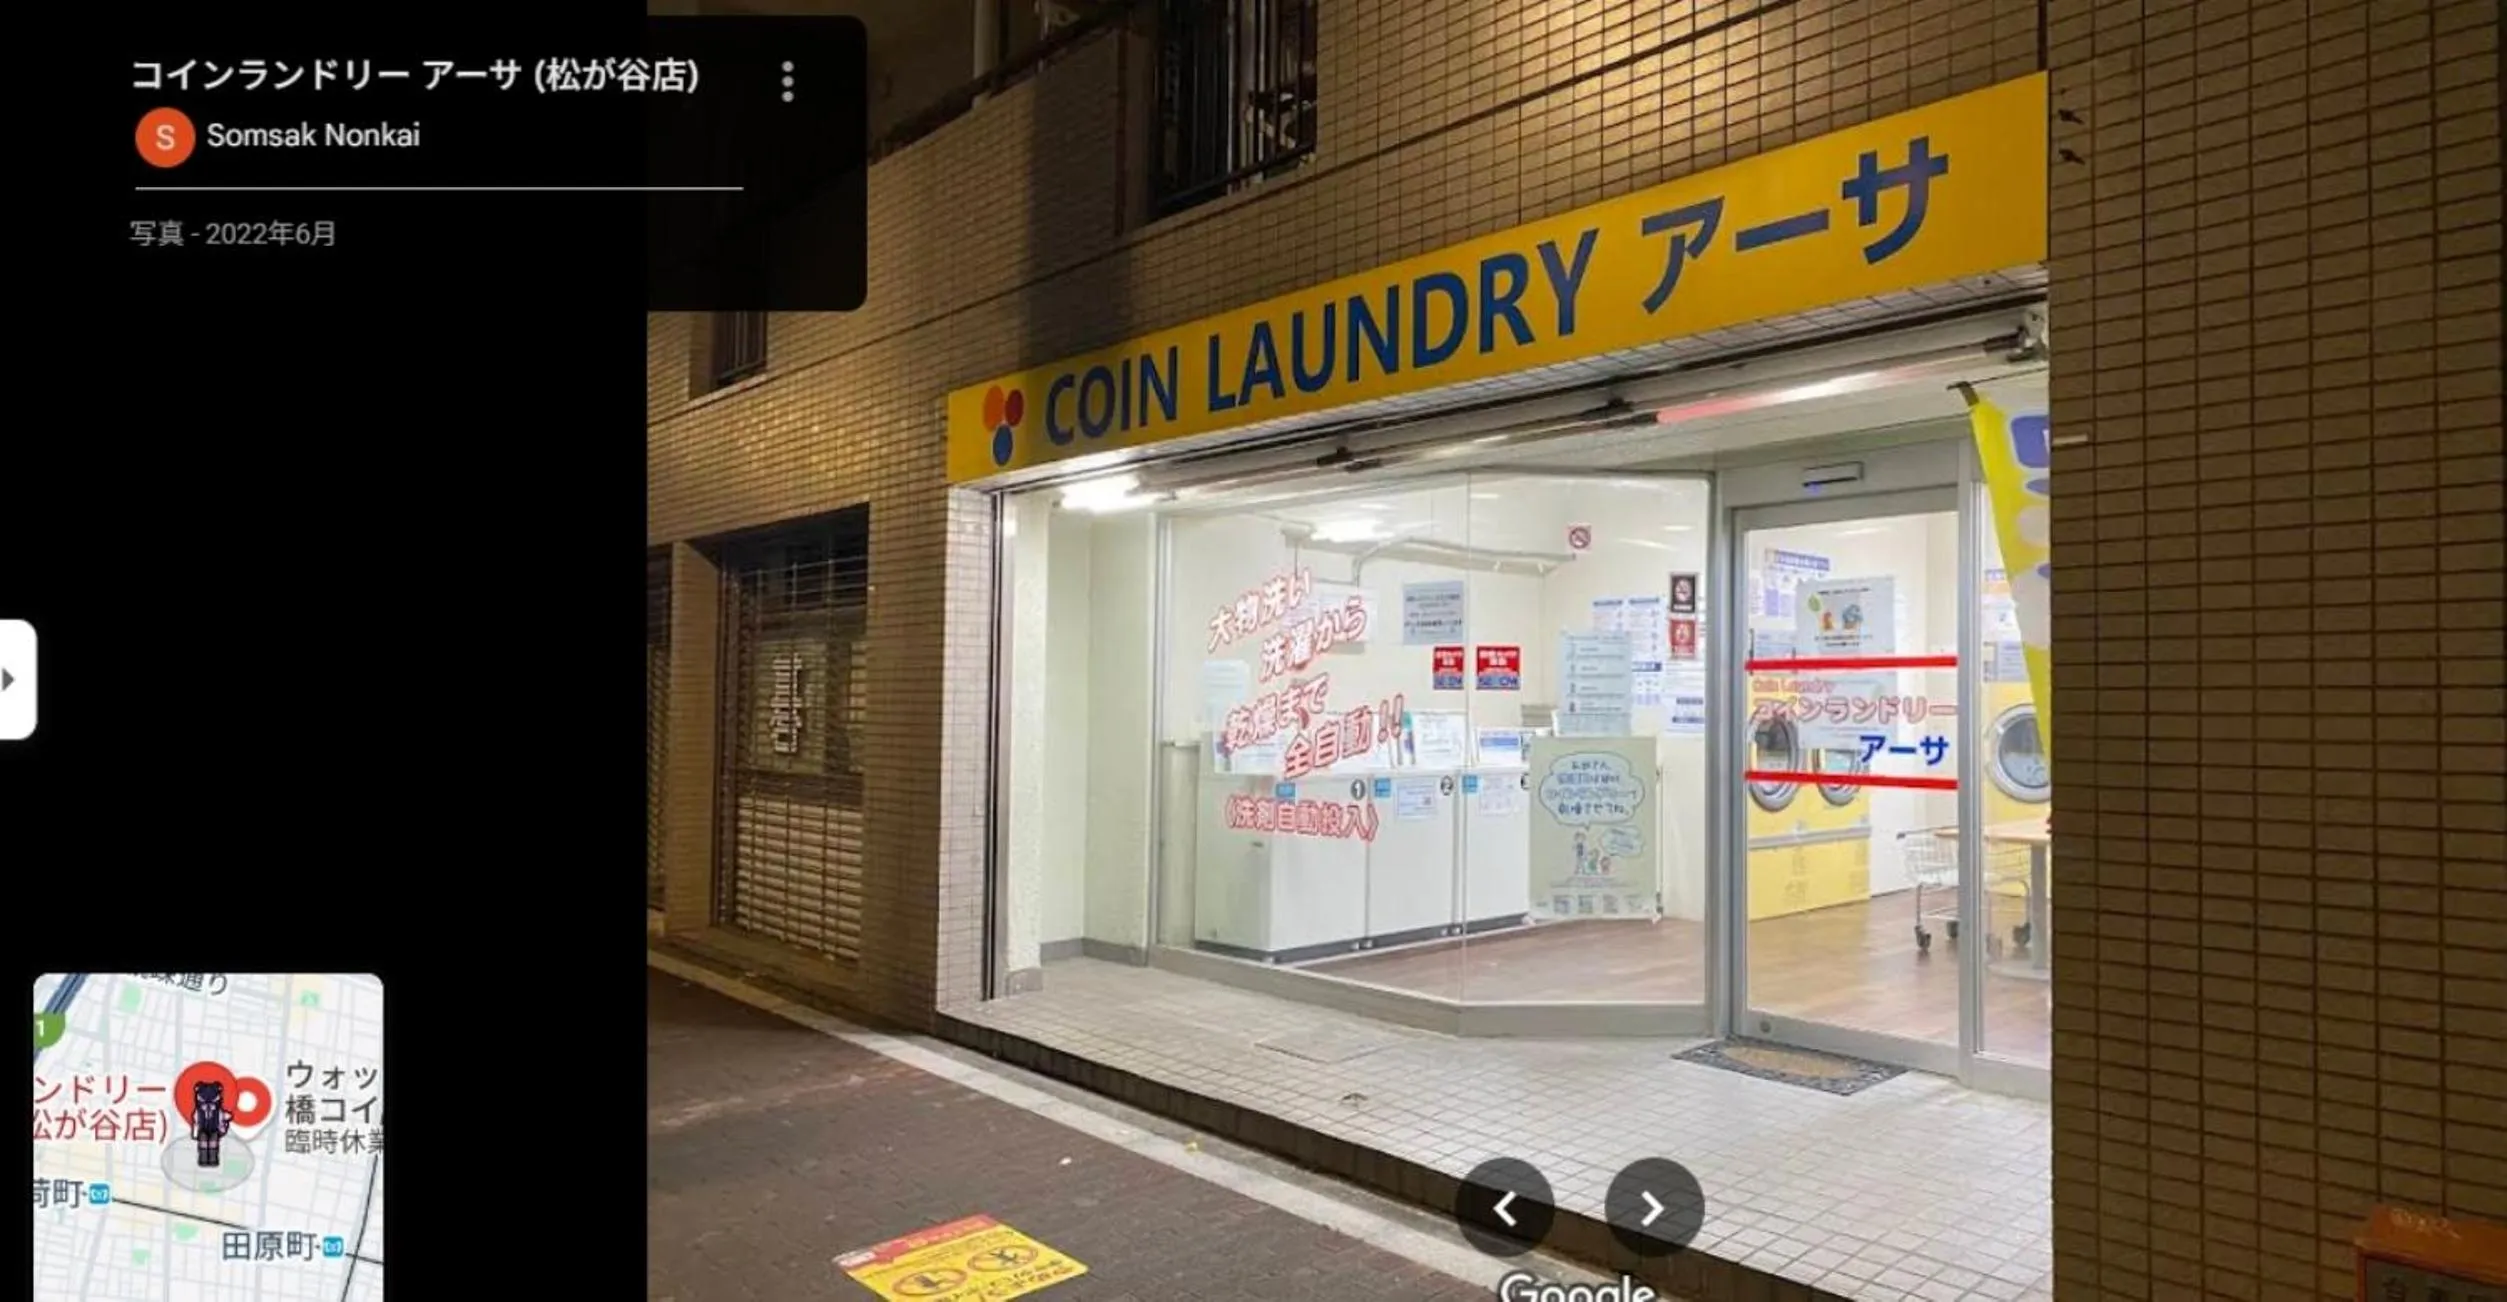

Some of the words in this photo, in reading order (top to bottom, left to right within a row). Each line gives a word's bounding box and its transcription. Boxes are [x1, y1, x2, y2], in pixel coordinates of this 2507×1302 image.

[1045, 349, 1179, 446] COIN
[1207, 228, 1598, 410] LAUNDRY
[1642, 137, 1949, 315] アーサ
[1207, 566, 1312, 655] 大物洗い
[1258, 595, 1368, 684] 洗濯から
[1751, 695, 1957, 725] コインランドリー
[1859, 734, 1950, 767] アーサ
